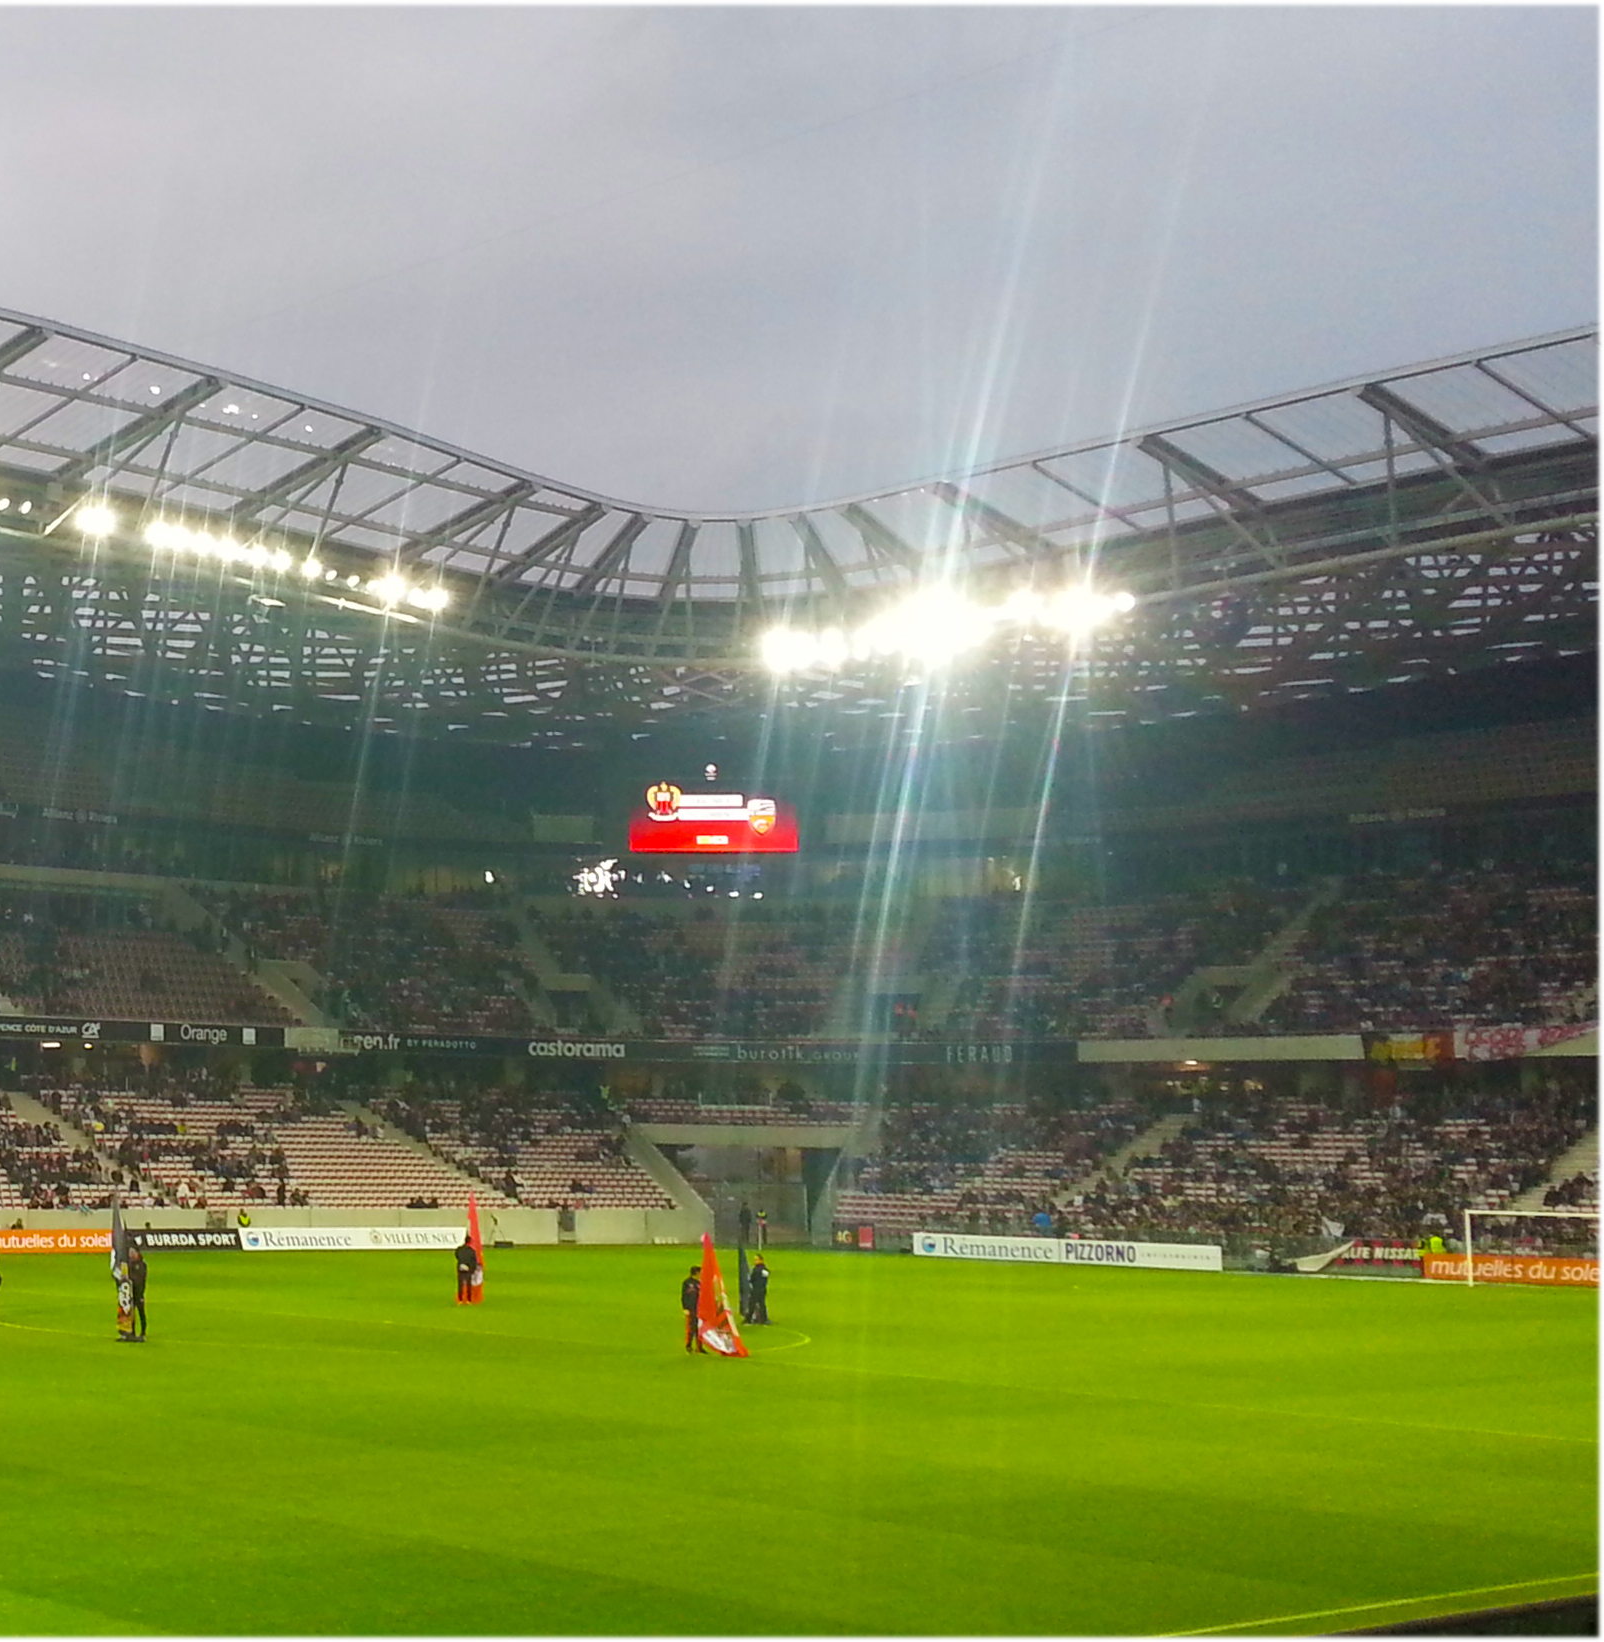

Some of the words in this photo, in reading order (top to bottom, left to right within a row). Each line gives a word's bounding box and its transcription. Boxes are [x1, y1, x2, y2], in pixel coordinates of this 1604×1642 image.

[24, 1022, 47, 1033] CÔTE
[48, 1025, 78, 1034] D'AZUR
[180, 1024, 228, 1045] Orange
[528, 1039, 625, 1058] castorama
[57, 1233, 77, 1248] du
[80, 1233, 112, 1248] soleil
[146, 1233, 196, 1246] BURRDA
[198, 1233, 236, 1246] SPORT
[262, 1231, 352, 1247] Rémanence
[384, 1233, 412, 1245] VILLE
[415, 1233, 430, 1244] DE
[432, 1233, 458, 1244] NICE
[943, 1236, 1053, 1260] Rémanence
[1065, 1243, 1137, 1263] PIZZORNO
[1528, 1261, 1557, 1279] du
